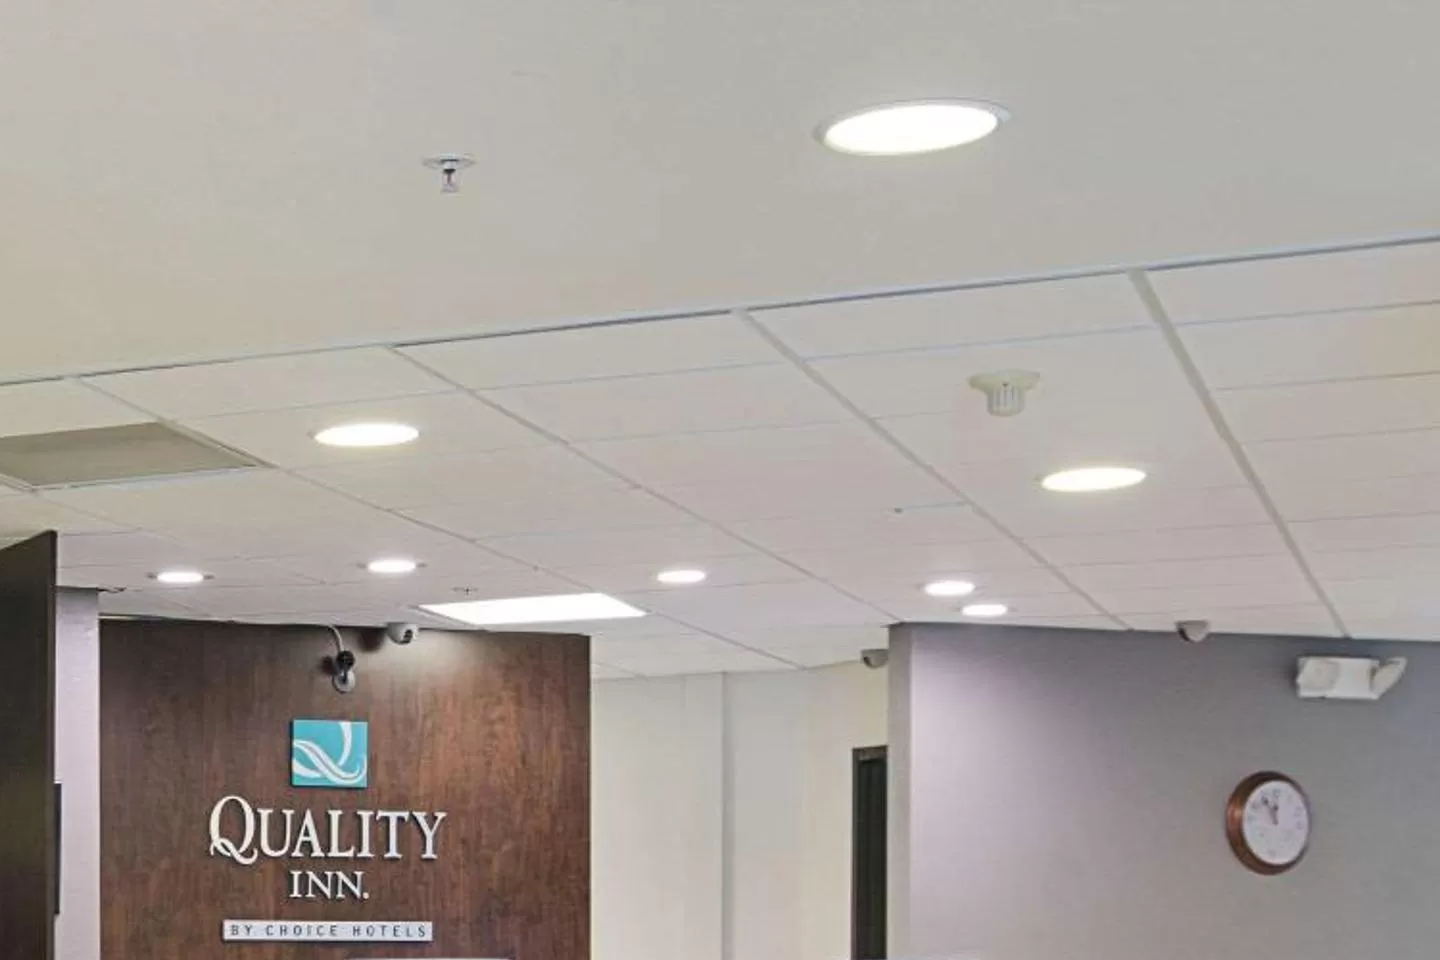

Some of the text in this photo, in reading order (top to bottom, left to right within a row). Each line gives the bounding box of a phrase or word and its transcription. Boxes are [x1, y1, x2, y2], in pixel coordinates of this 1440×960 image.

[209, 795, 447, 865] QUALITY
[230, 924, 427, 938] BY CHOICE HOTELS
